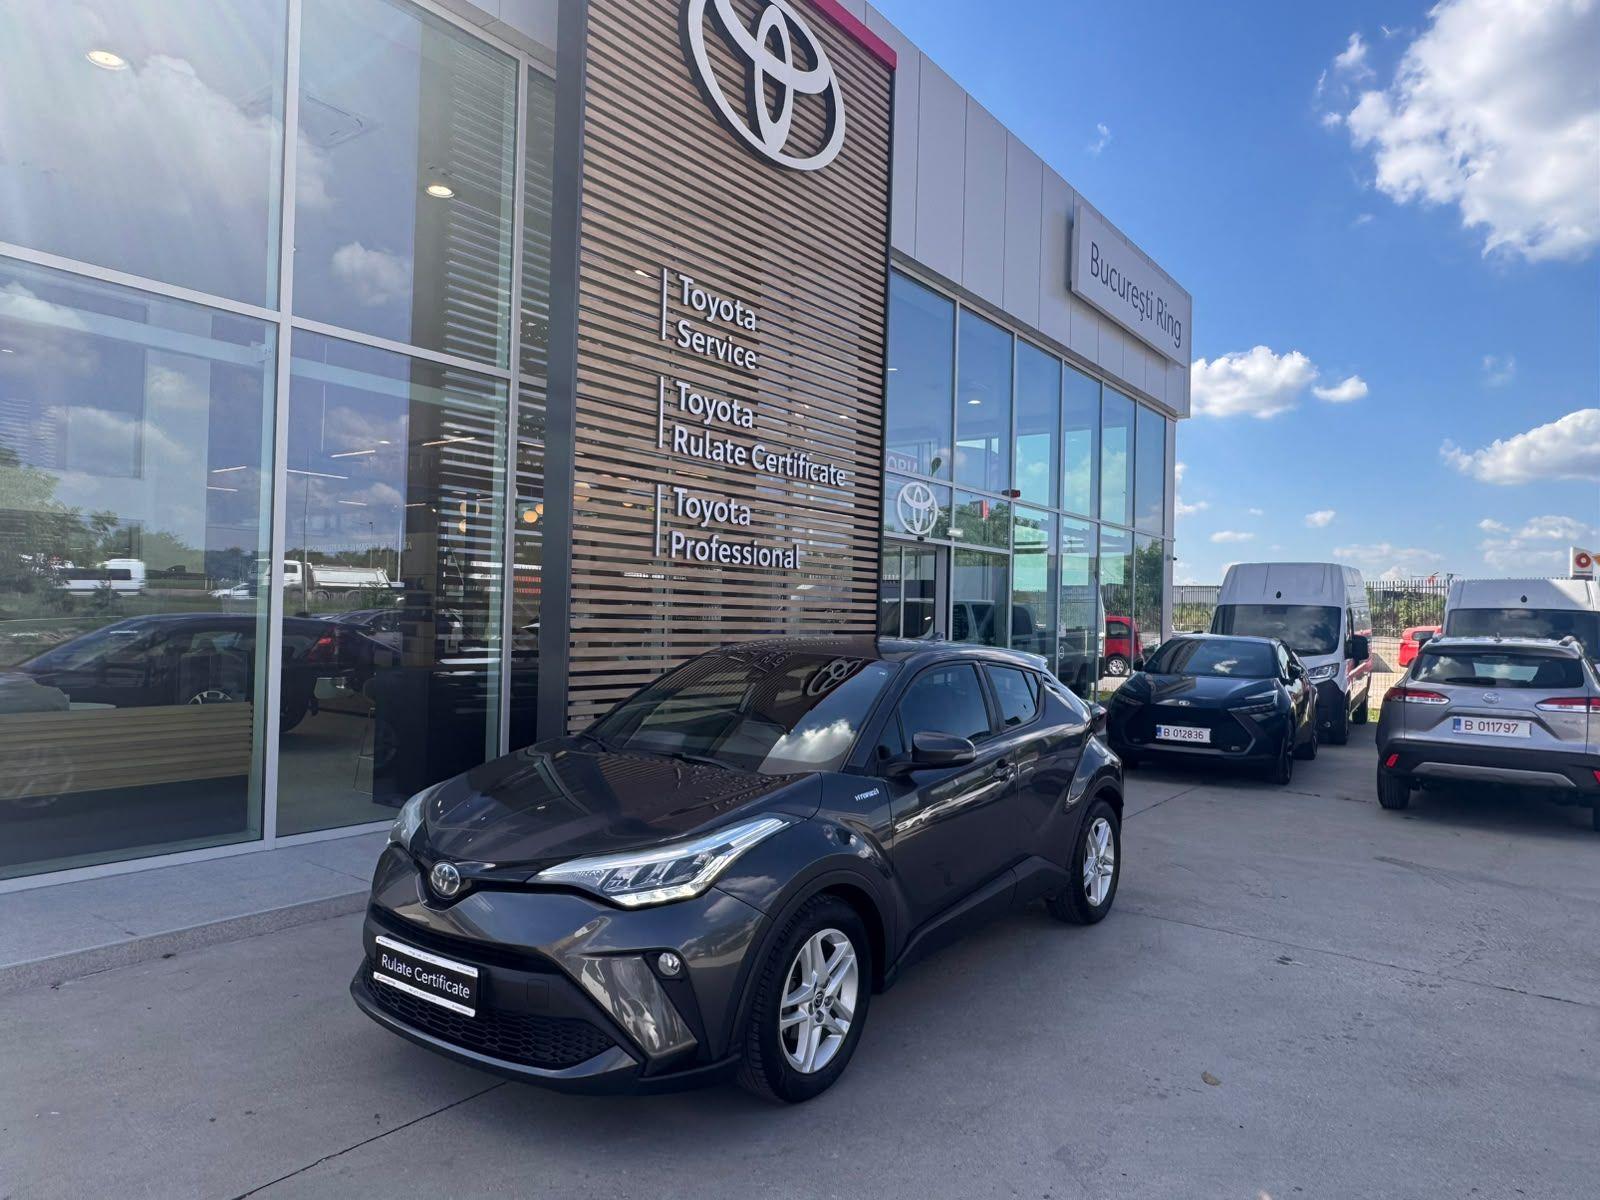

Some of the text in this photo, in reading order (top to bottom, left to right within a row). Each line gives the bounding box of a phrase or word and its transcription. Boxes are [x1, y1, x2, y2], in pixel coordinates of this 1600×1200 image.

[678, 274, 756, 331] Toyota
[1156, 297, 1182, 349] Ring
[677, 319, 757, 370] Service
[676, 380, 753, 428] Toyota
[673, 425, 747, 466] Rulate
[752, 444, 846, 487] Certificate
[672, 487, 751, 527] Toyota
[670, 531, 801, 569] Professional
[1163, 728, 1204, 739] B 012836
[1464, 720, 1519, 734] B 011797
[381, 953, 412, 977] Rulate
[414, 967, 470, 999] Certificate
